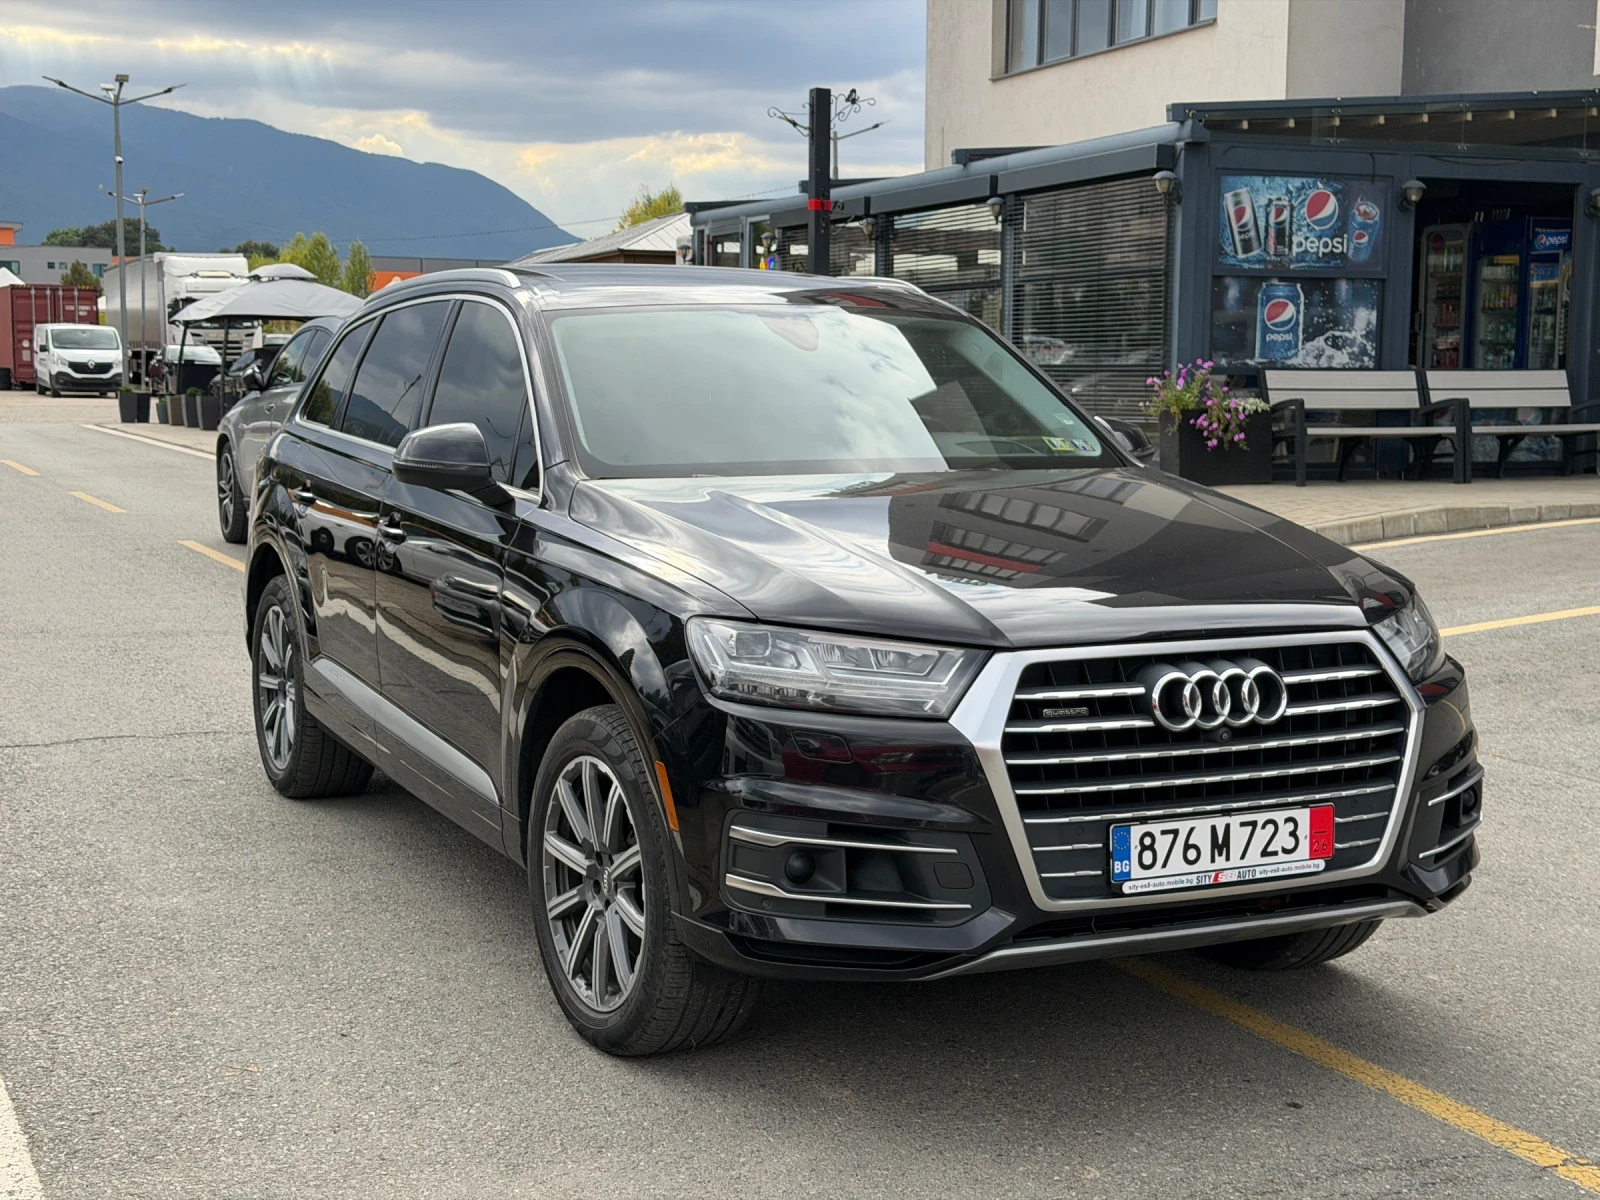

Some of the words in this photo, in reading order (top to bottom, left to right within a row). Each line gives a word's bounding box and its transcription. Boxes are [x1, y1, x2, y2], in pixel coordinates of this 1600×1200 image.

[1292, 234, 1348, 258] pepsi
[1266, 332, 1293, 343] pepsi
[1313, 839, 1328, 853] 26
[1114, 860, 1130, 874] BG
[1195, 874, 1213, 885] SITY
[1237, 869, 1257, 880] AUTO
